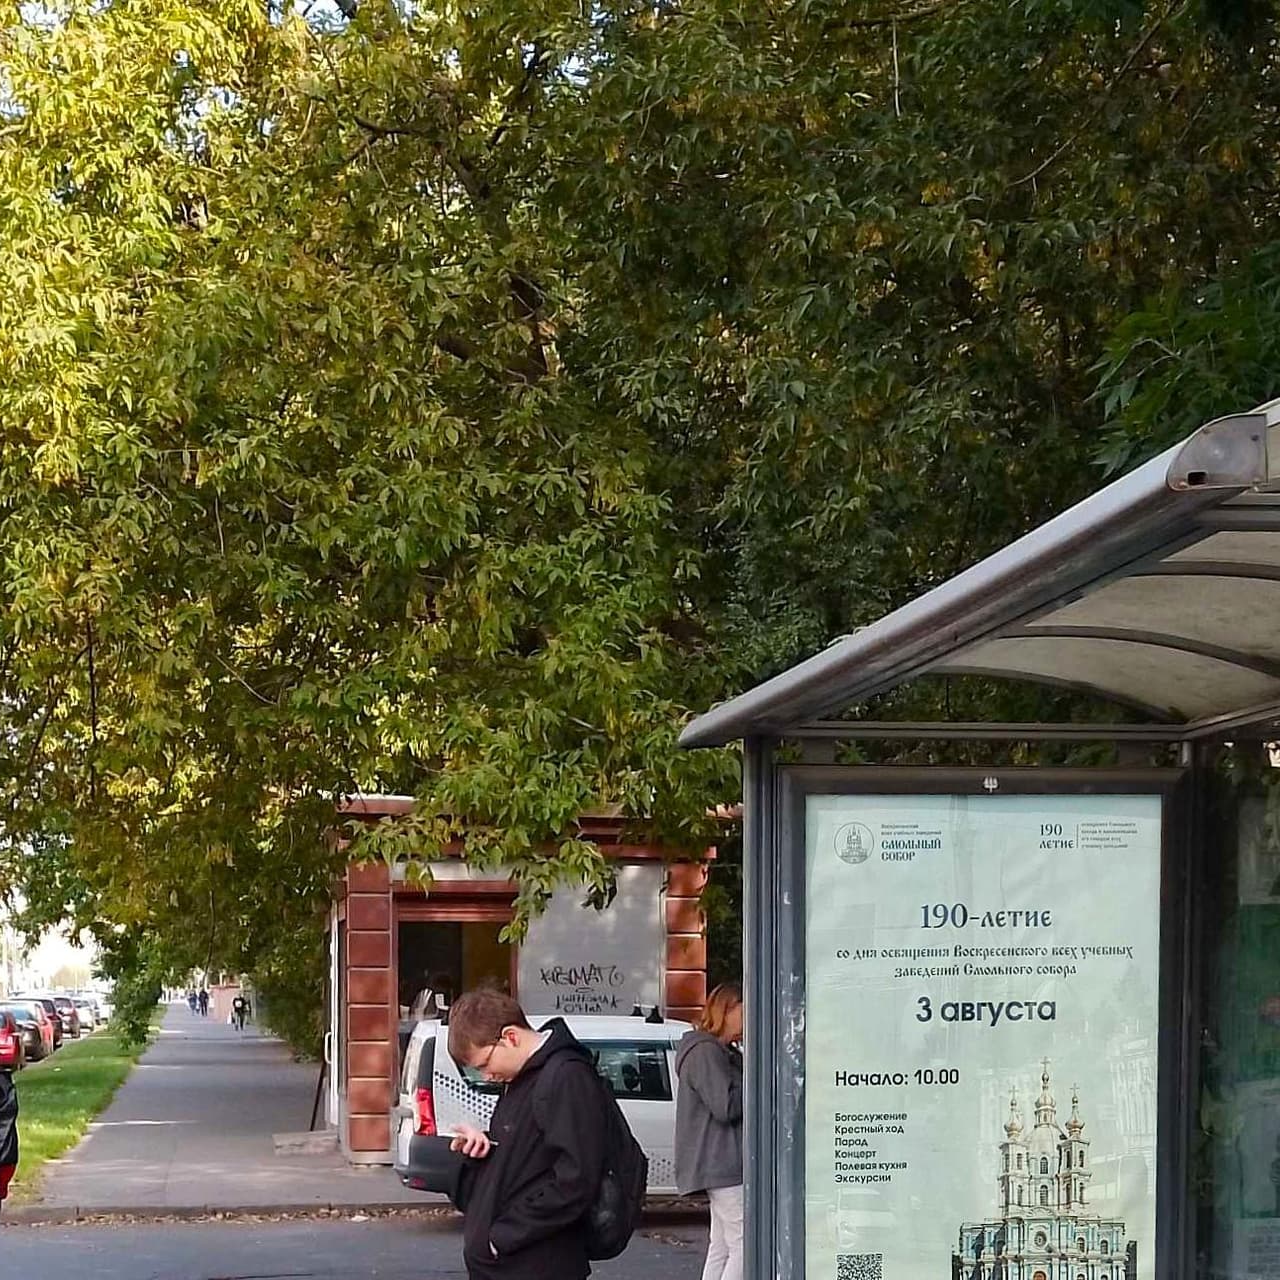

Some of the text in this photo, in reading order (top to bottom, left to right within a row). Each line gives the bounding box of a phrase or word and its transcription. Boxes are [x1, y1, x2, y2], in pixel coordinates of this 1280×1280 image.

[1039, 823, 1063, 837] 190
[881, 838, 941, 850] СМОЛЬНЫЙ
[881, 851, 916, 861] СОБОР
[836, 944, 1133, 961] со дня освящения Воскресенского всех учебных
[894, 963, 1077, 979] заведений Смольного собора
[916, 997, 1057, 1027] 3 августа
[835, 1068, 960, 1087] Начало: 10.00
[835, 1112, 908, 1123] Богослужение
[835, 1124, 905, 1136] Крестный ход
[835, 1137, 869, 1148] Парад
[835, 1149, 877, 1160] Концерт
[835, 1161, 908, 1171] Полевая кухня
[835, 1173, 892, 1184] Экскурсии
